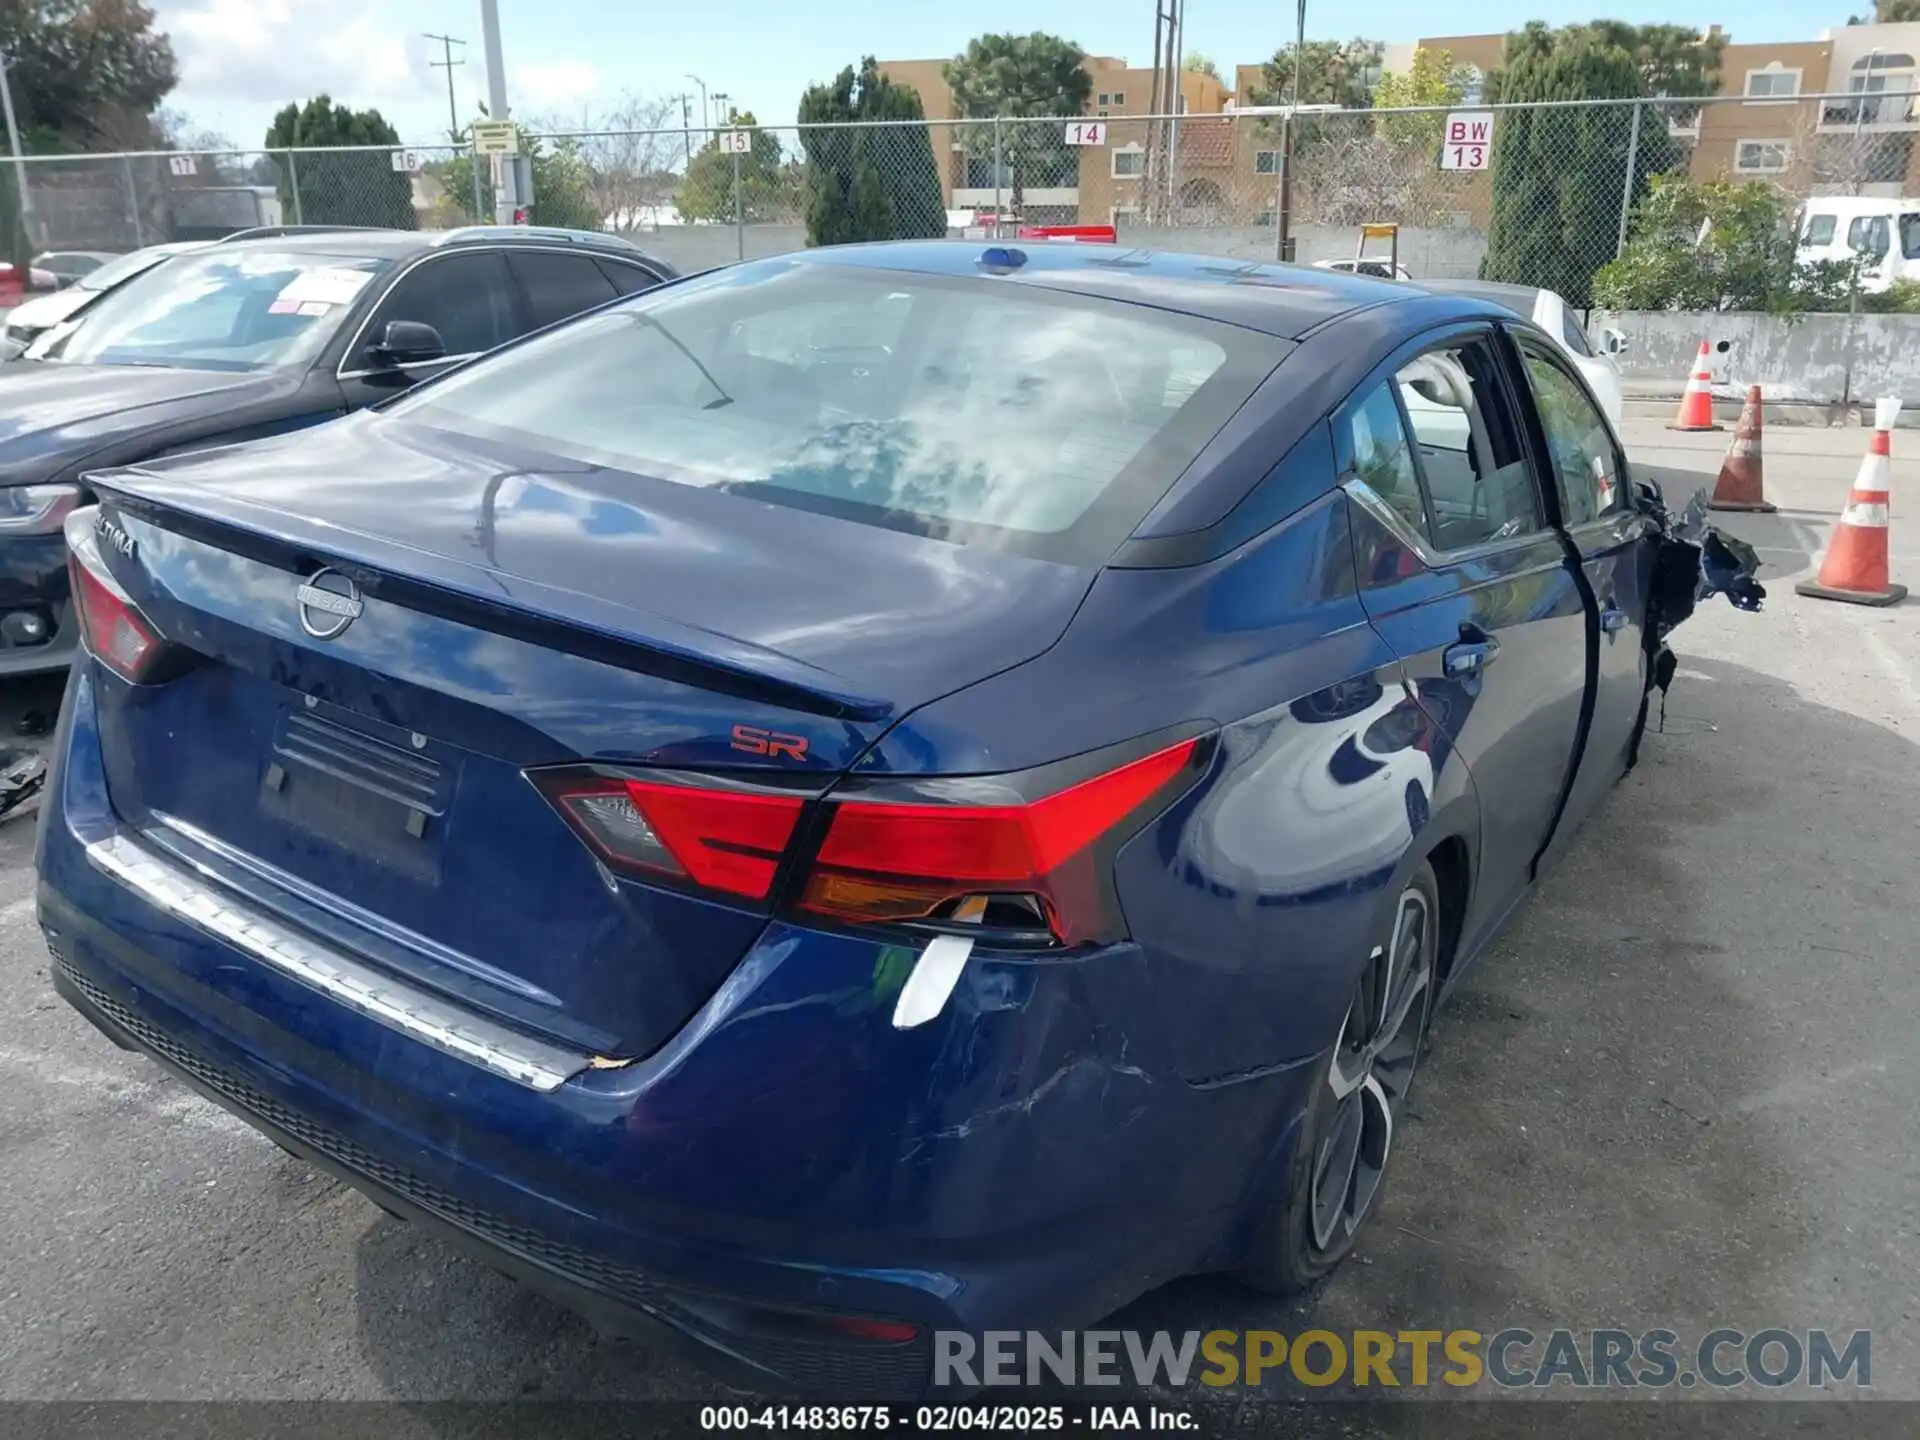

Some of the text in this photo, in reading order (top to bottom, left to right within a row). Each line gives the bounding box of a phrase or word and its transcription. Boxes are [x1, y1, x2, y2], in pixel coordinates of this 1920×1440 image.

[725, 133, 745, 150] 15
[1074, 124, 1098, 143] 14
[175, 158, 192, 175] 17
[398, 153, 416, 170] 16
[1453, 146, 1483, 168] 13
[298, 586, 361, 617] NISSAN
[730, 725, 808, 762] SR
